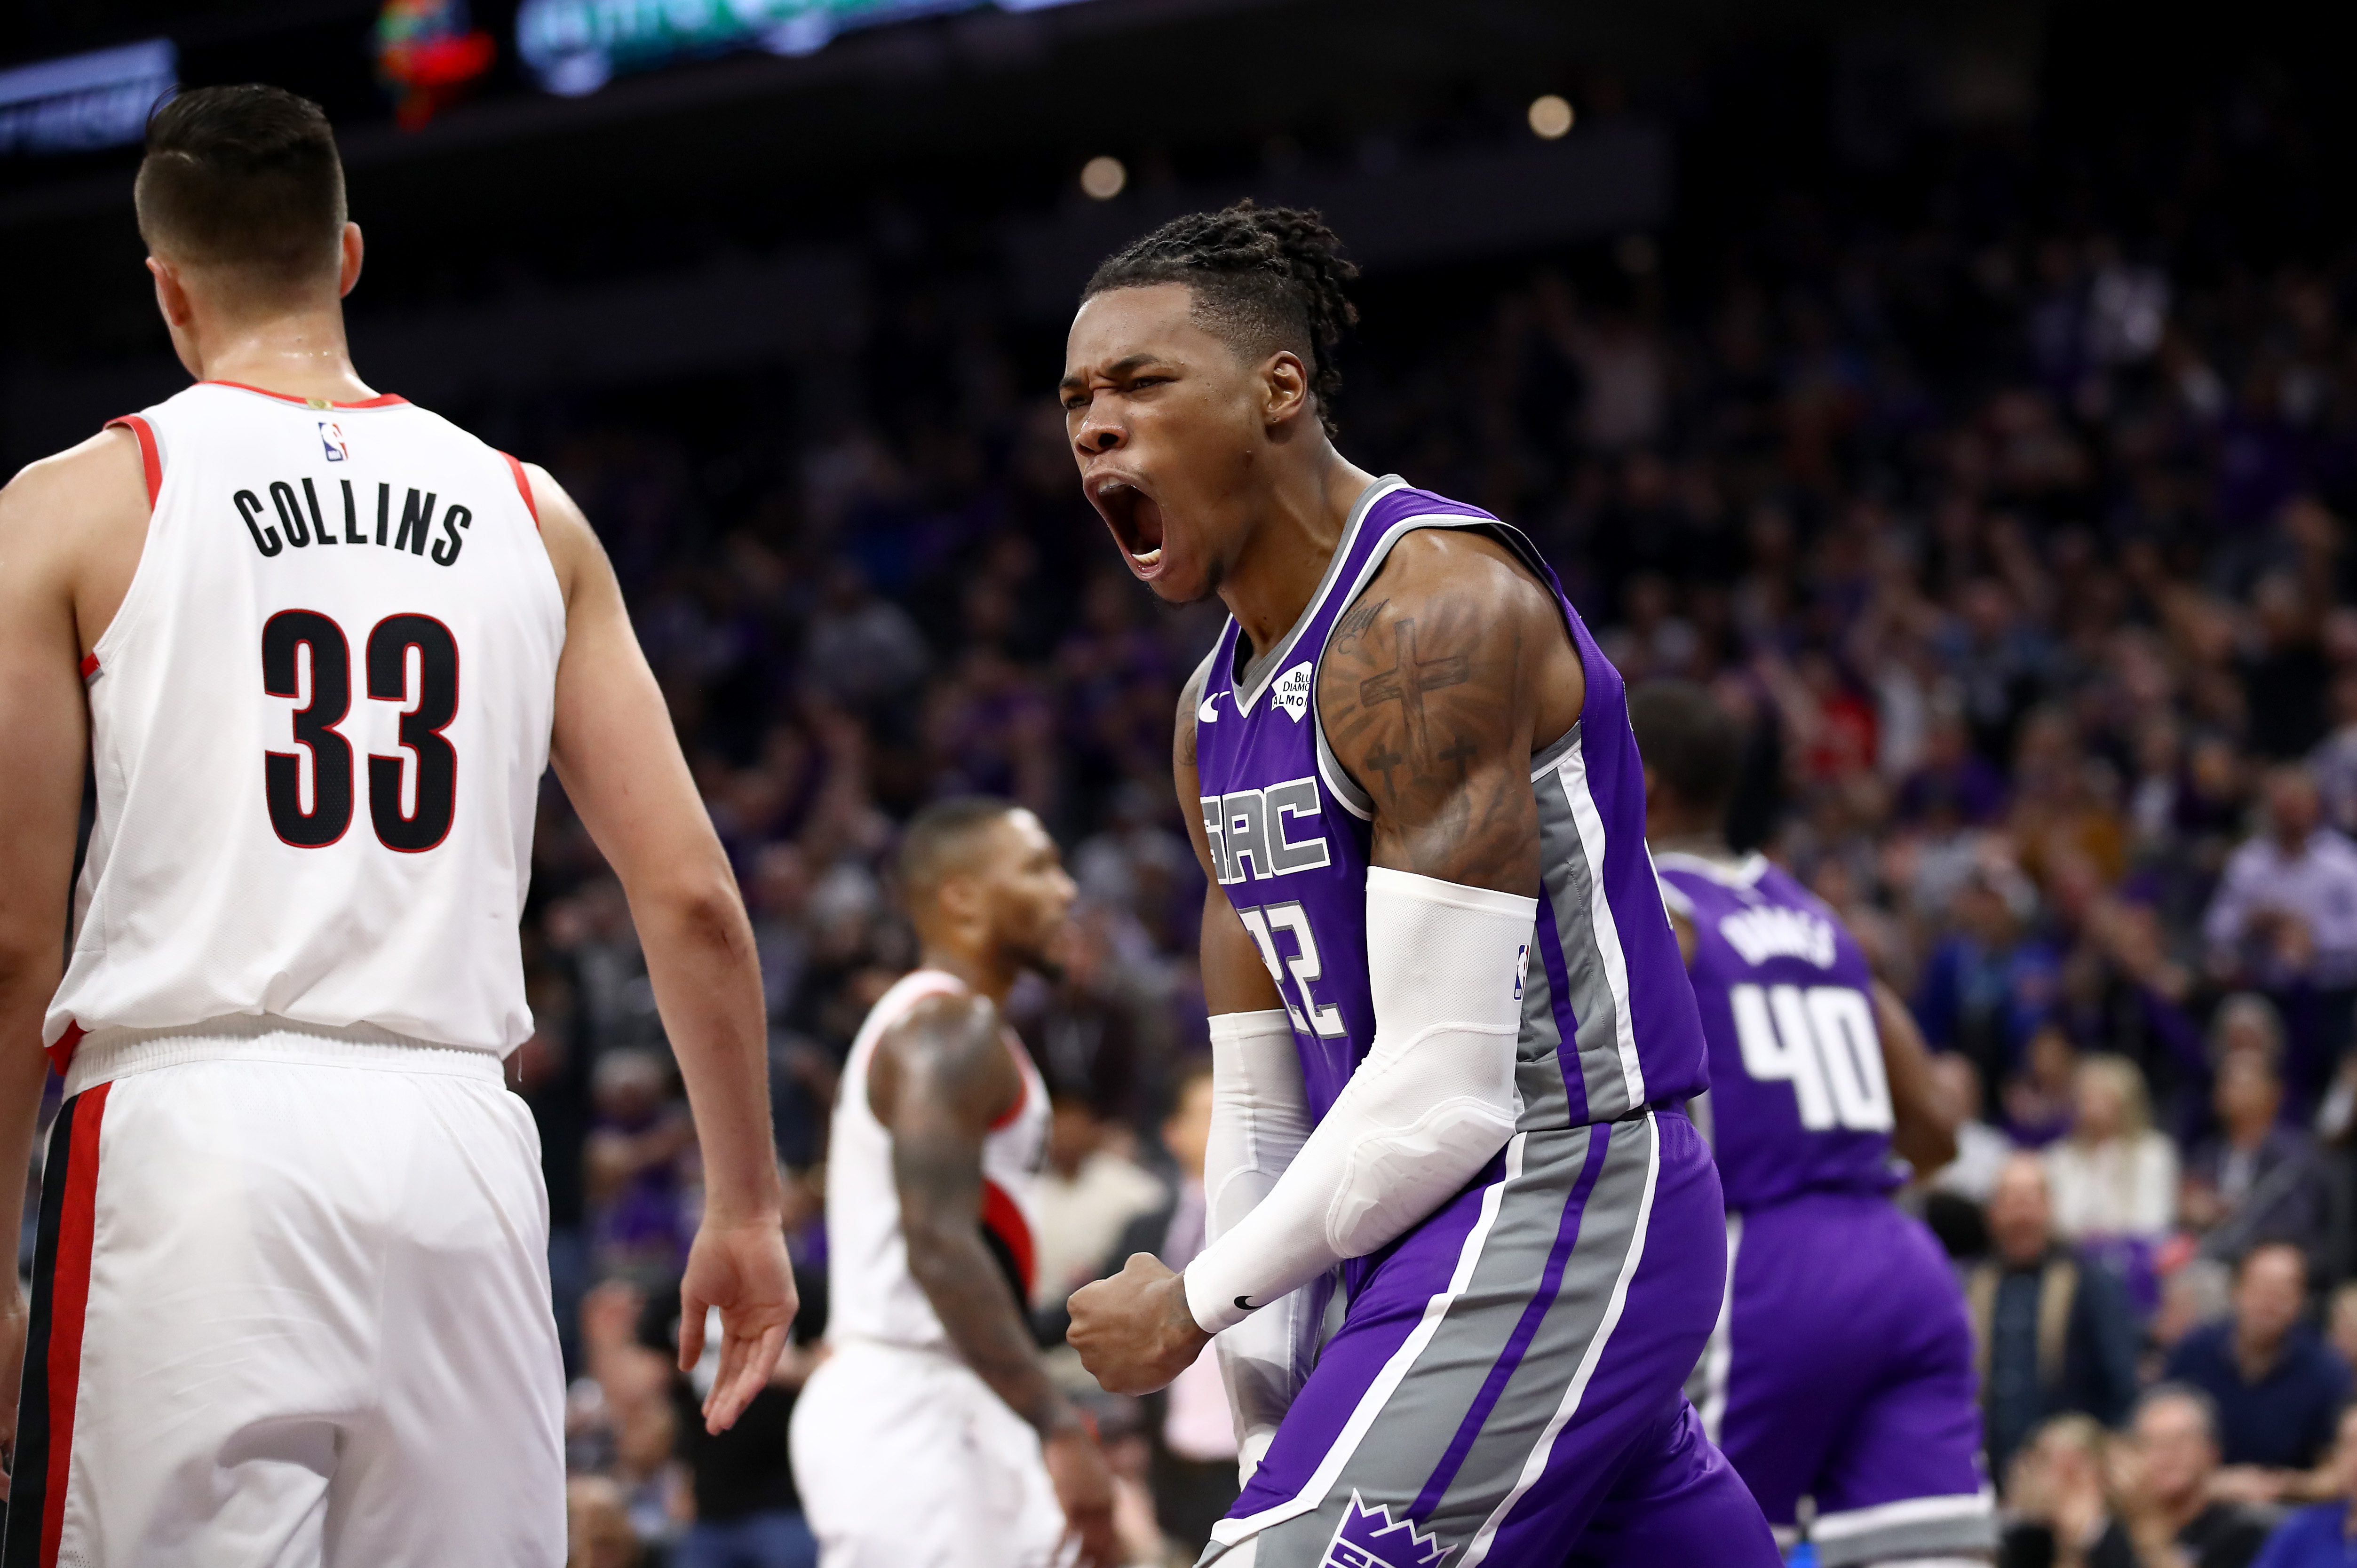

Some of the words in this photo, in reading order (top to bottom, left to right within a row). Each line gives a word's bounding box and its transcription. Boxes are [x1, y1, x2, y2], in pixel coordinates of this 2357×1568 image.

[234, 477, 472, 567] COLLINS
[262, 609, 459, 853] 33
[1200, 776, 1331, 885] SAC
[1729, 982, 1896, 1132] 40
